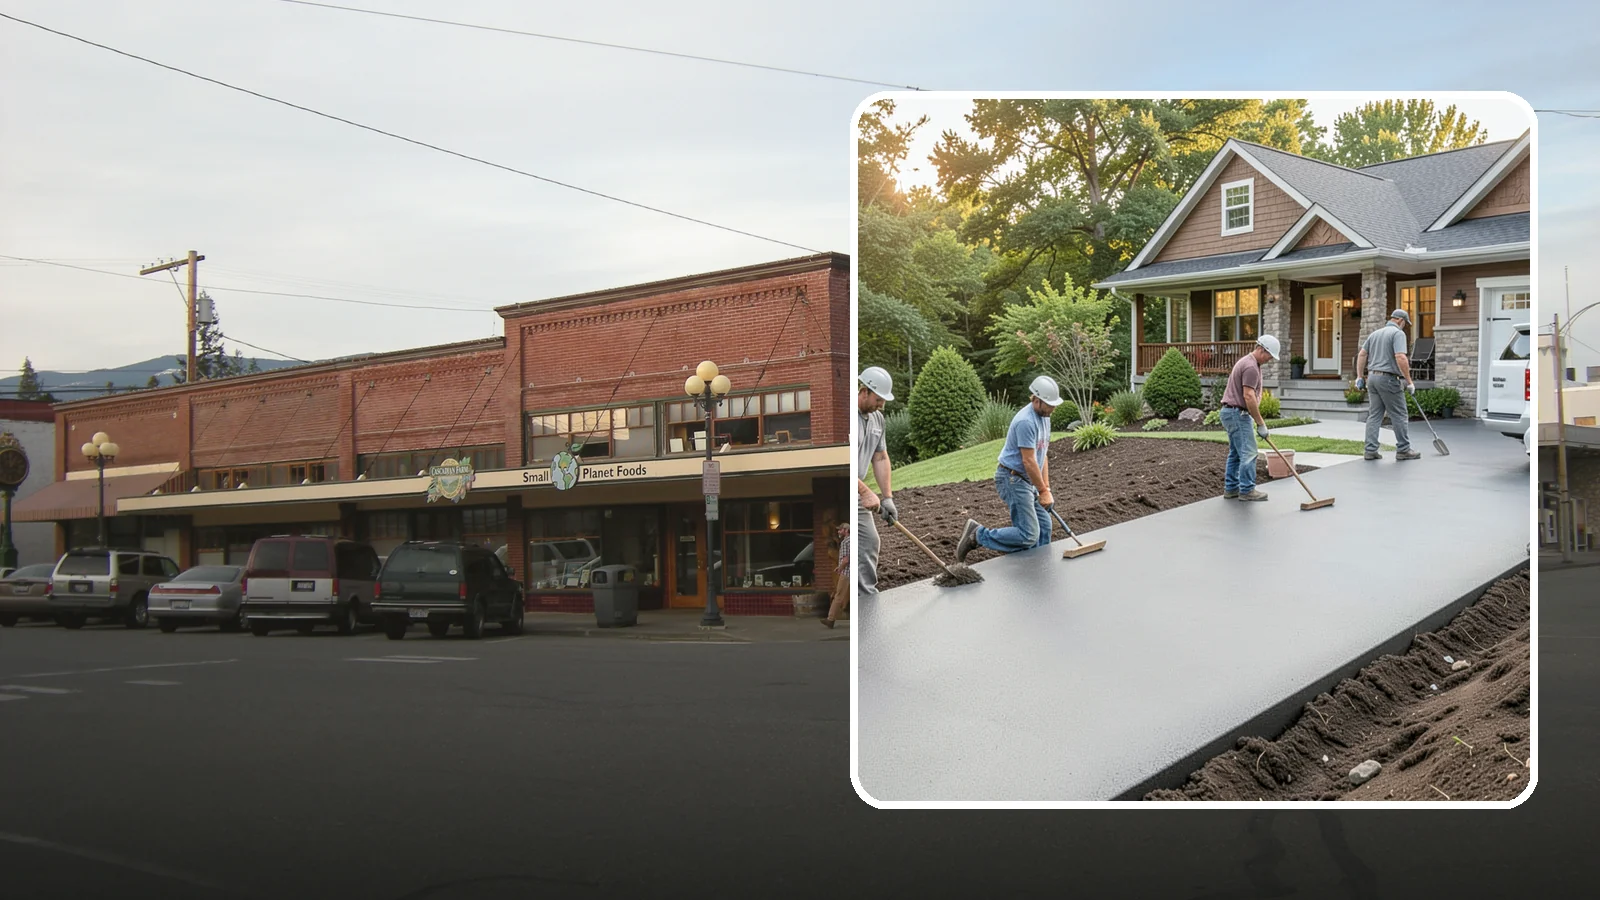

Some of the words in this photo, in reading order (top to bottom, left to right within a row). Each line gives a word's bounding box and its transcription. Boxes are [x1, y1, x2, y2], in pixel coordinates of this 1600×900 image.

[523, 470, 549, 483] Small
[583, 467, 614, 479] Planet
[617, 464, 647, 477] Foods
